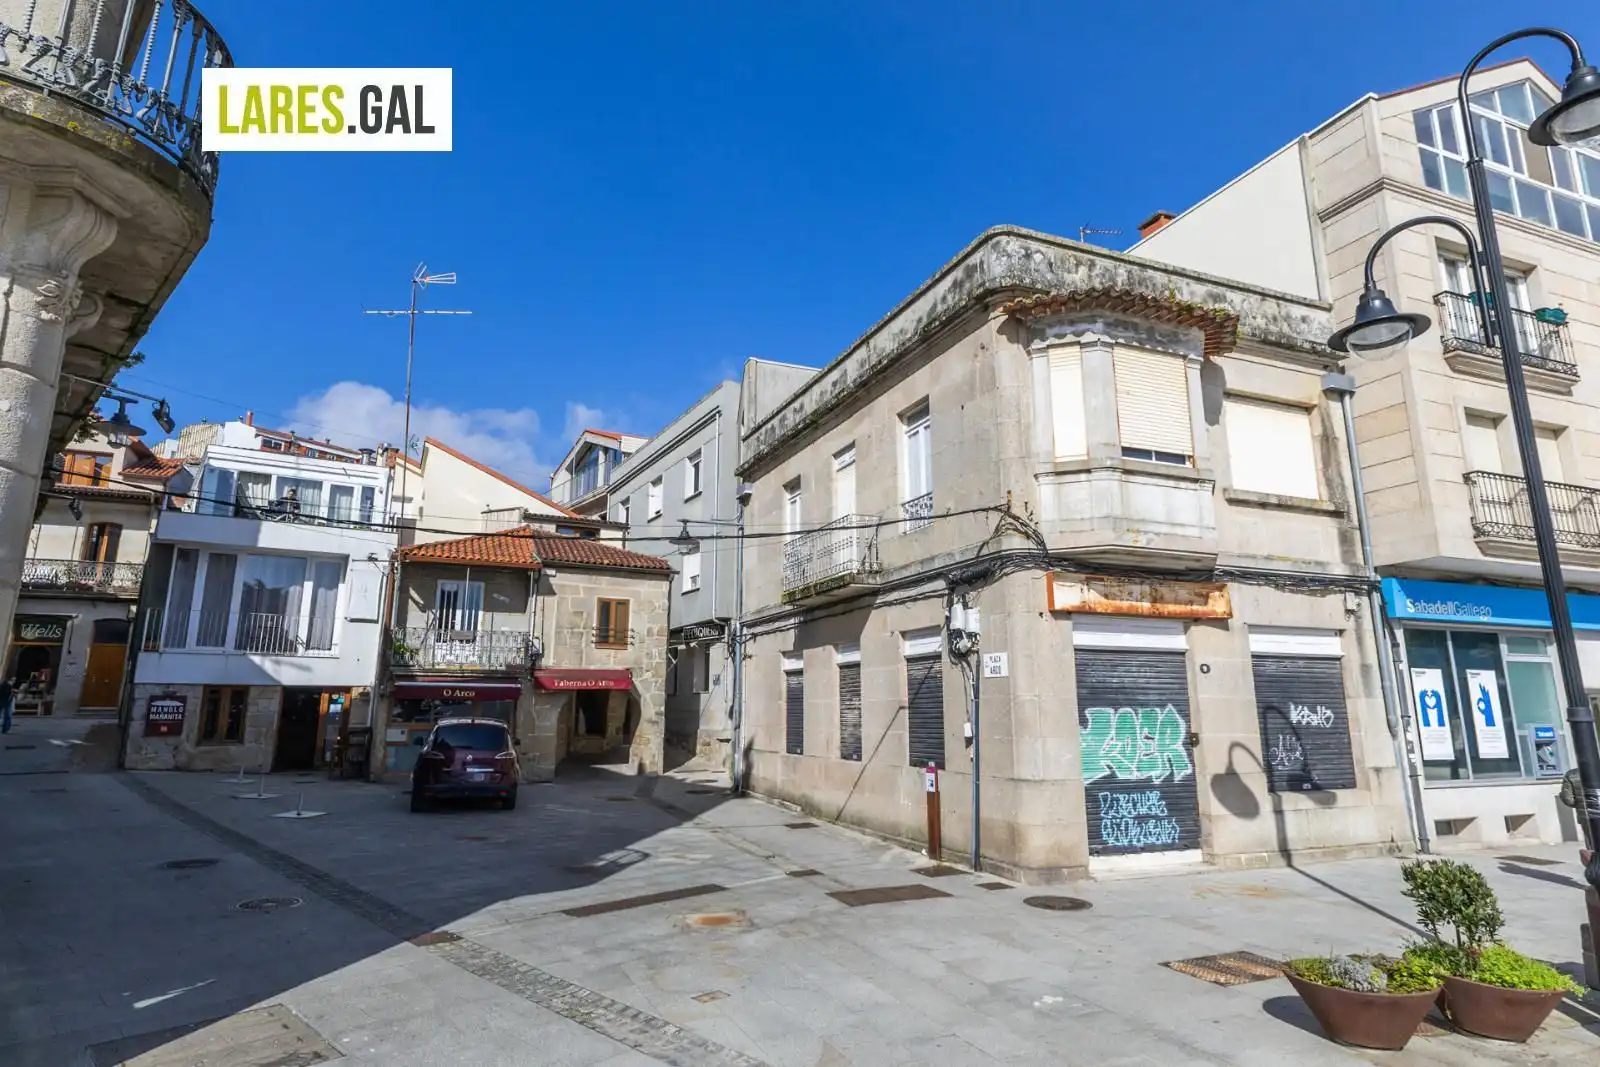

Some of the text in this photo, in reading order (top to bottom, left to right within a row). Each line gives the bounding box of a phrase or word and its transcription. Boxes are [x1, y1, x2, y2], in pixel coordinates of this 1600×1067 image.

[21, 623, 63, 638] Wells
[553, 679, 615, 687] Taberna O Arco
[443, 688, 476, 697] O Arco
